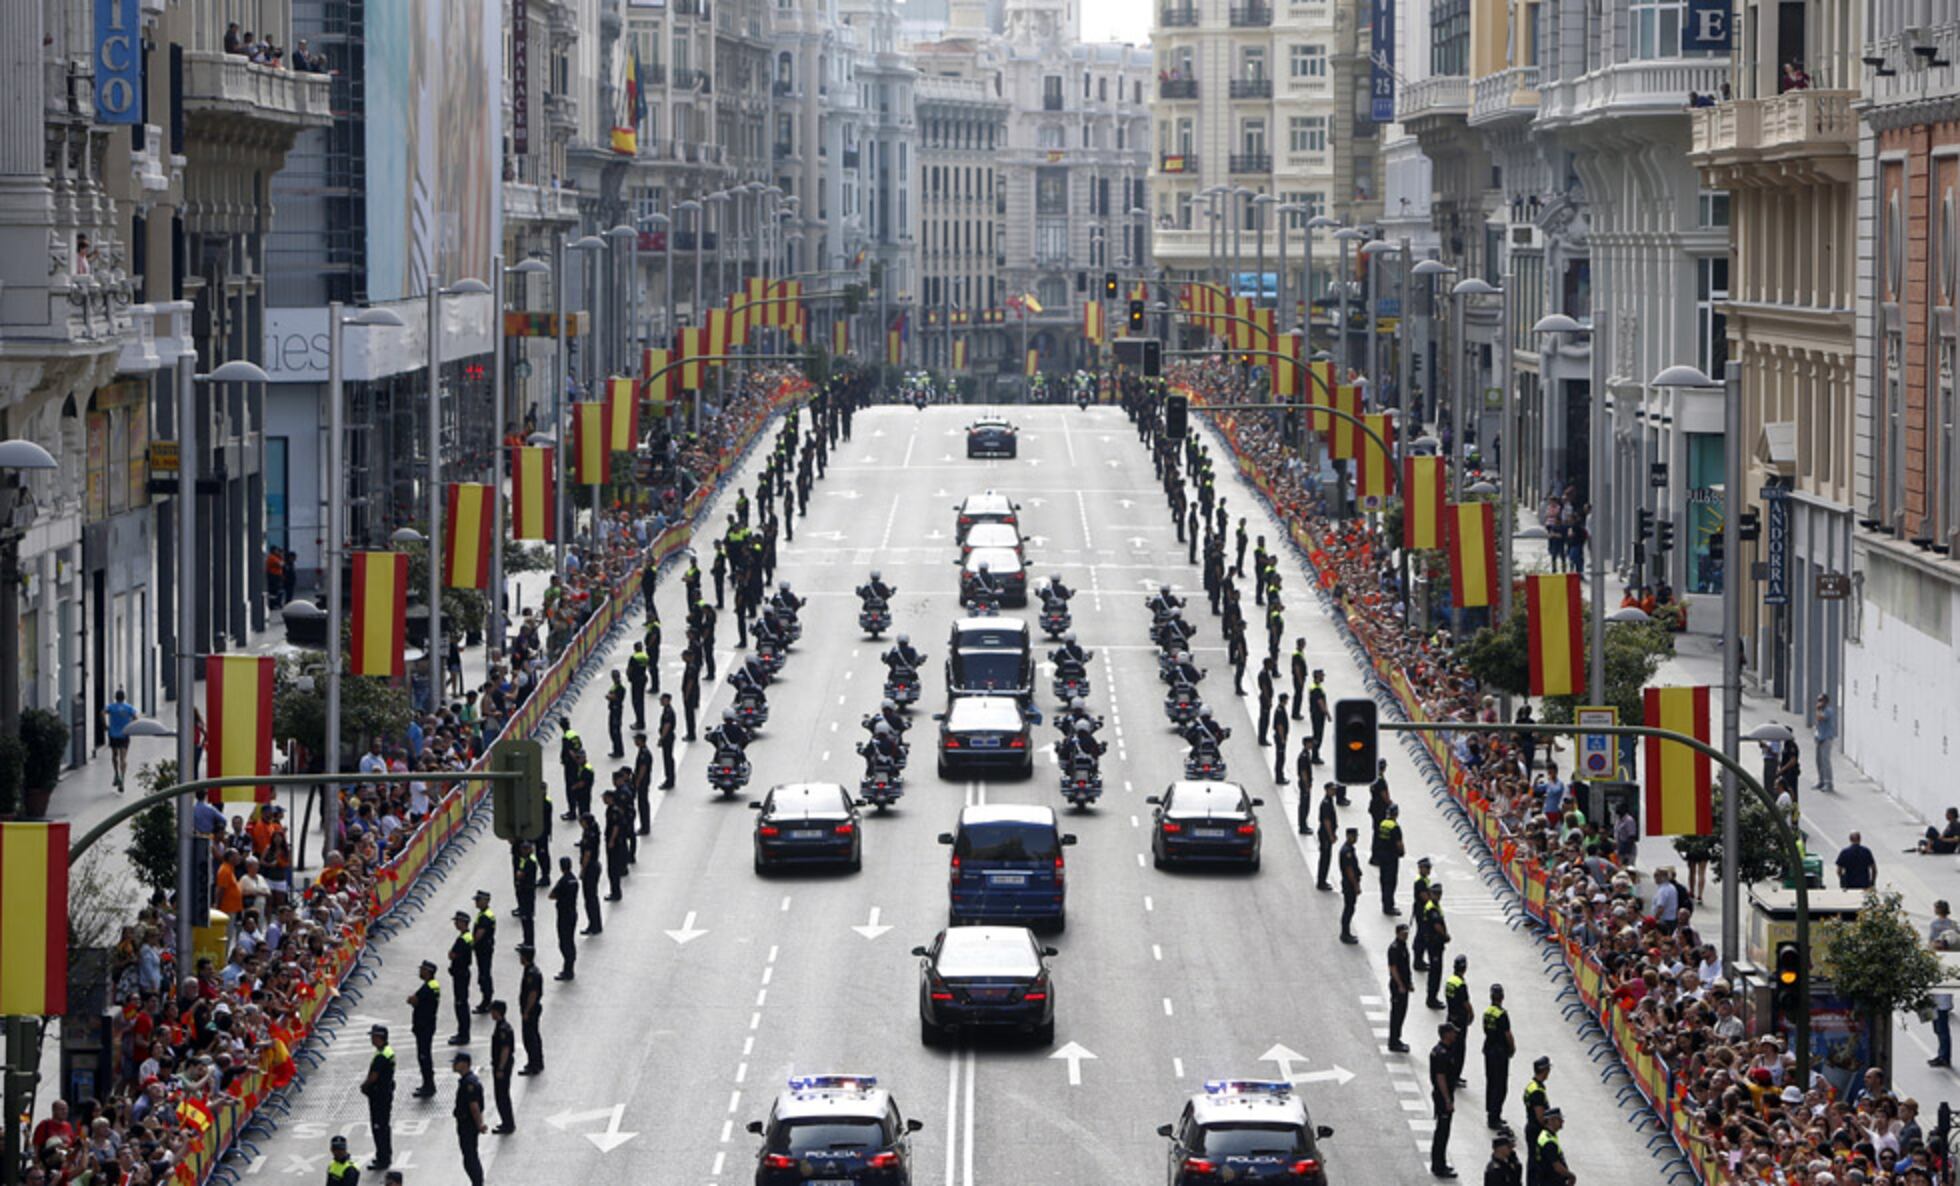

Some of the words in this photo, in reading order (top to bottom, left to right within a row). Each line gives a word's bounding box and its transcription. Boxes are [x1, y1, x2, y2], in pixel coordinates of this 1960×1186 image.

[1695, 9, 1726, 41] E
[516, 41, 525, 125] PALACE
[265, 321, 329, 372] ies
[1770, 501, 1783, 594] ANDORRA
[804, 1150, 857, 1159] POLICIA
[1226, 1155, 1278, 1164] POLICIA
